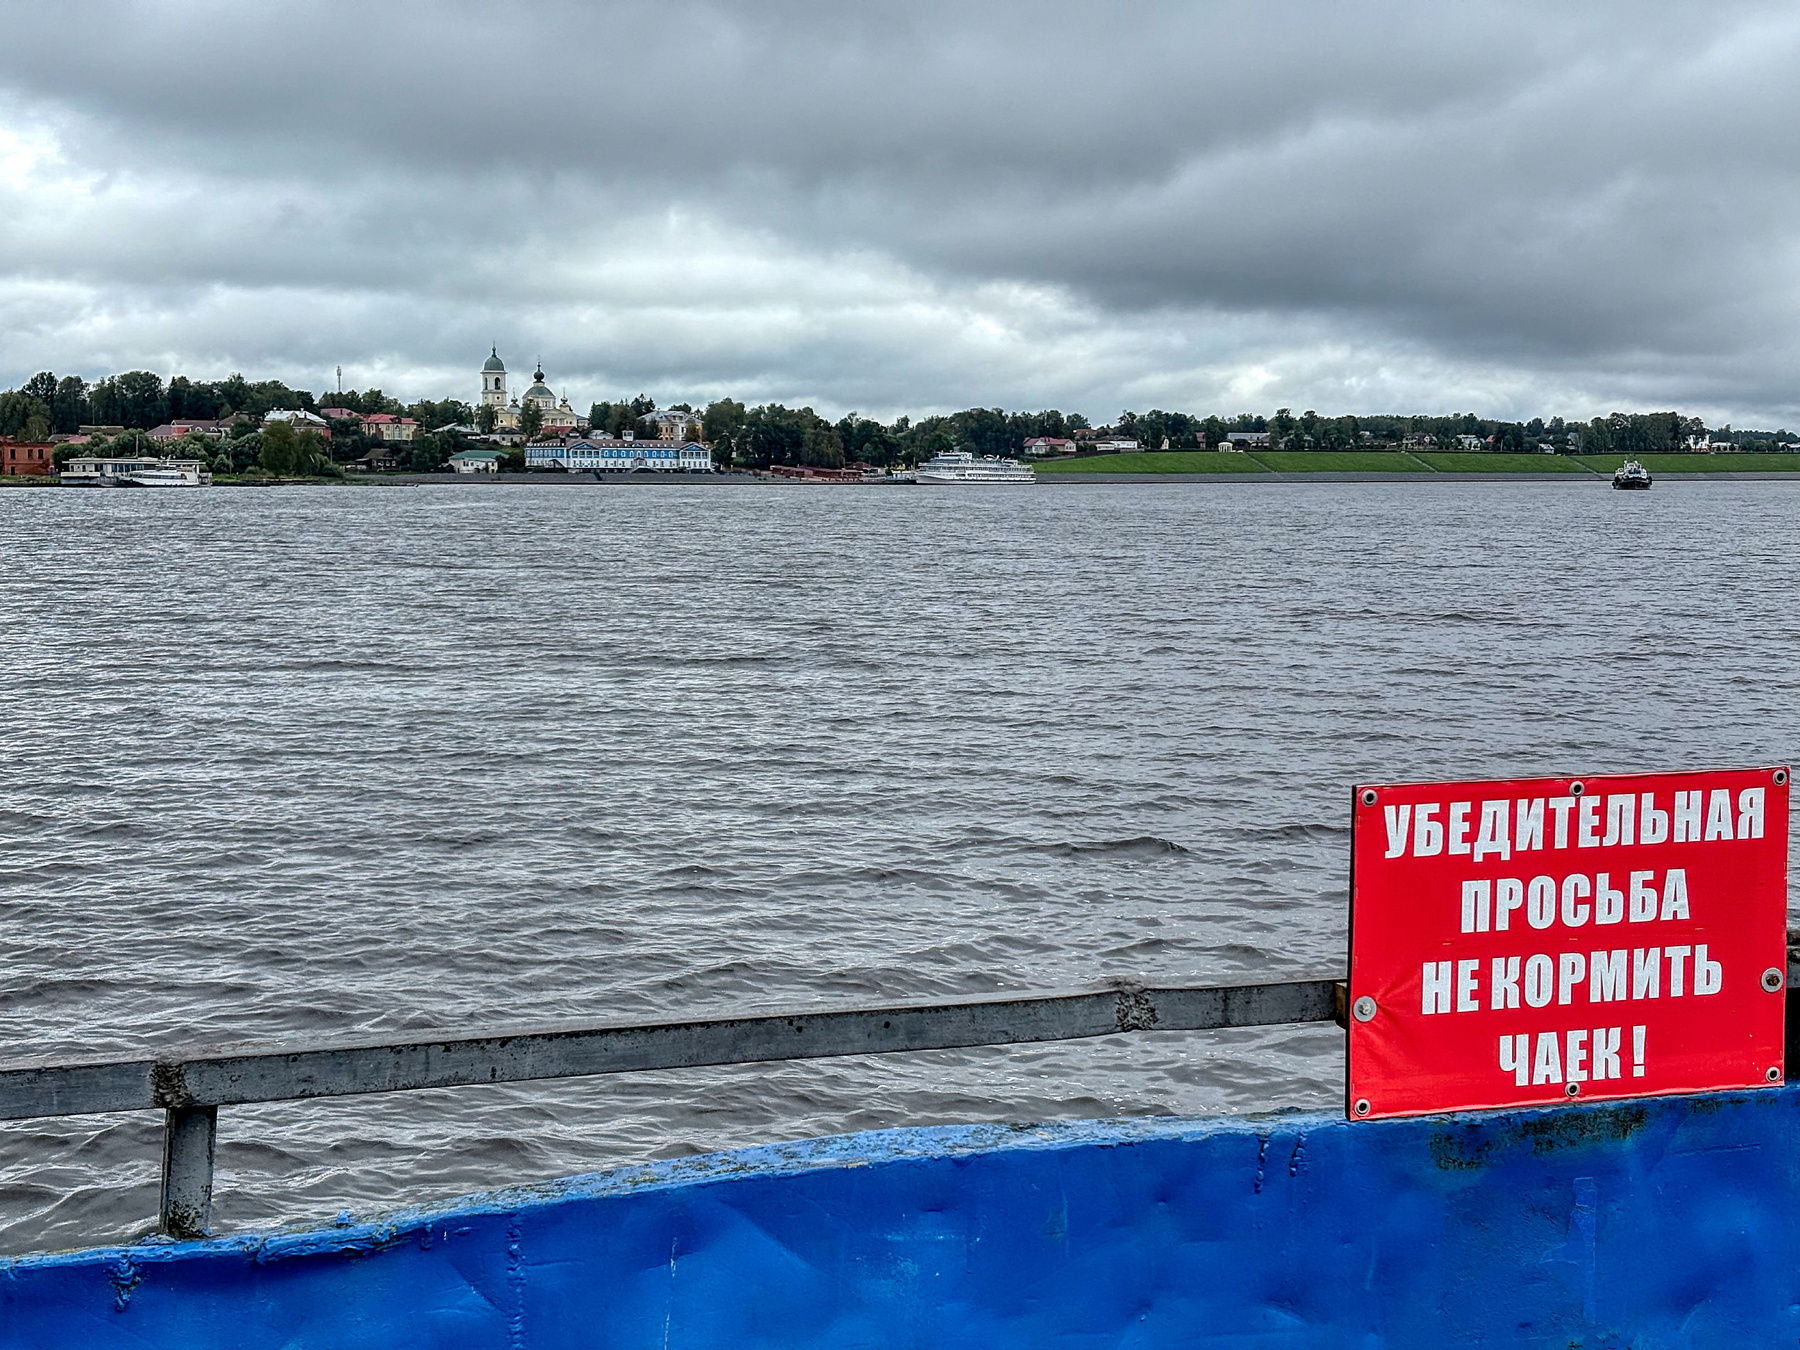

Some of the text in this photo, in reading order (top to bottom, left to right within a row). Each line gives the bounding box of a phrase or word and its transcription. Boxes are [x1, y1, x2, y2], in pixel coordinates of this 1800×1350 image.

[1384, 787, 1765, 862] УБЕДИТЕЛЬНАЯ
[1461, 869, 1690, 933] ПРОСЬБА
[1422, 944, 1722, 1014] НЕ КОРМИТЬ
